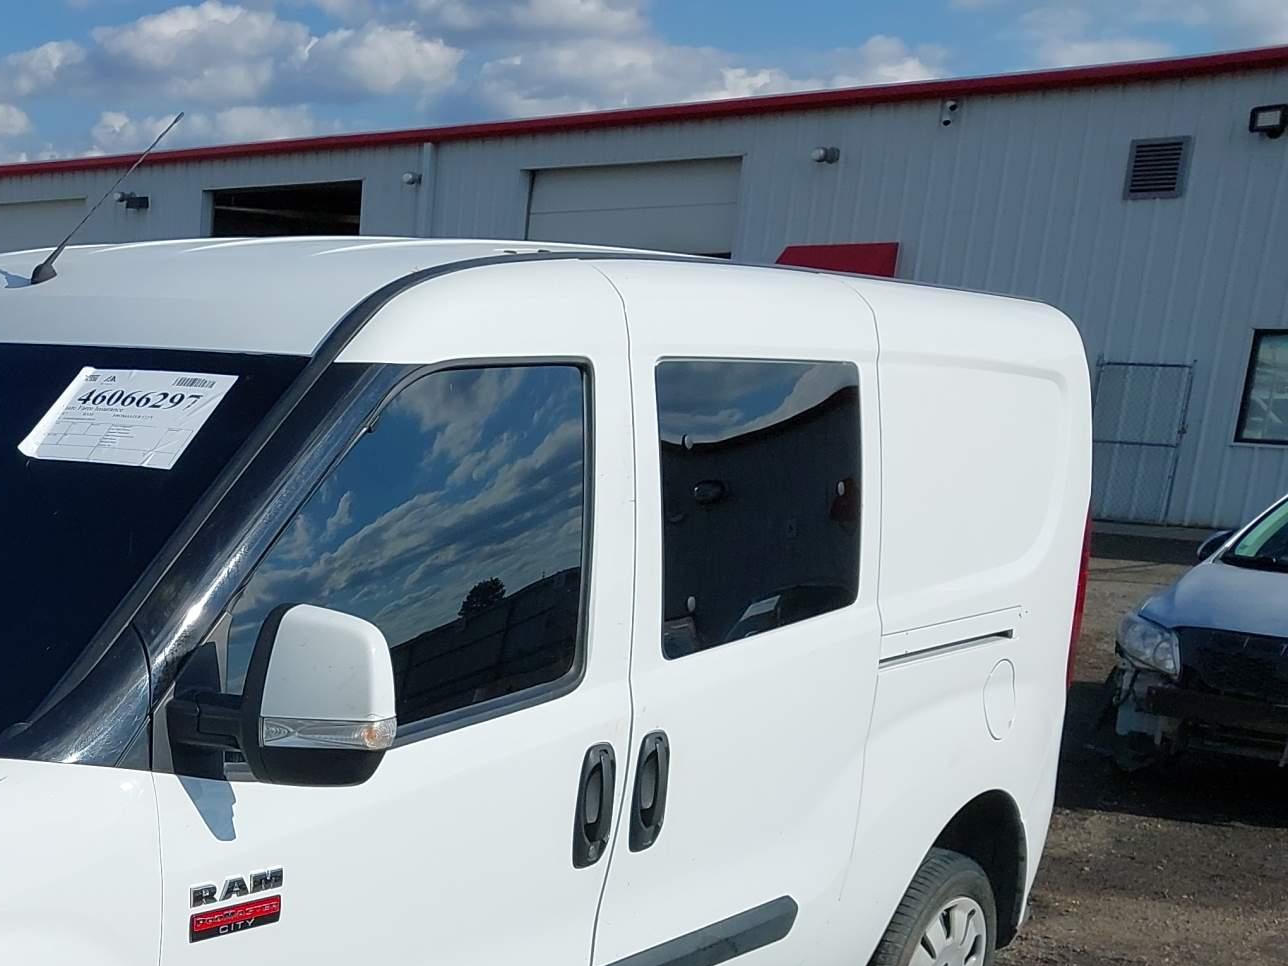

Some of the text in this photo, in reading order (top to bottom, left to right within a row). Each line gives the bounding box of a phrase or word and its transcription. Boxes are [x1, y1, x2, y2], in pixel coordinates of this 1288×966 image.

[77, 389, 204, 410] 46066297
[190, 867, 283, 908] RAM
[219, 918, 255, 934] CITY
